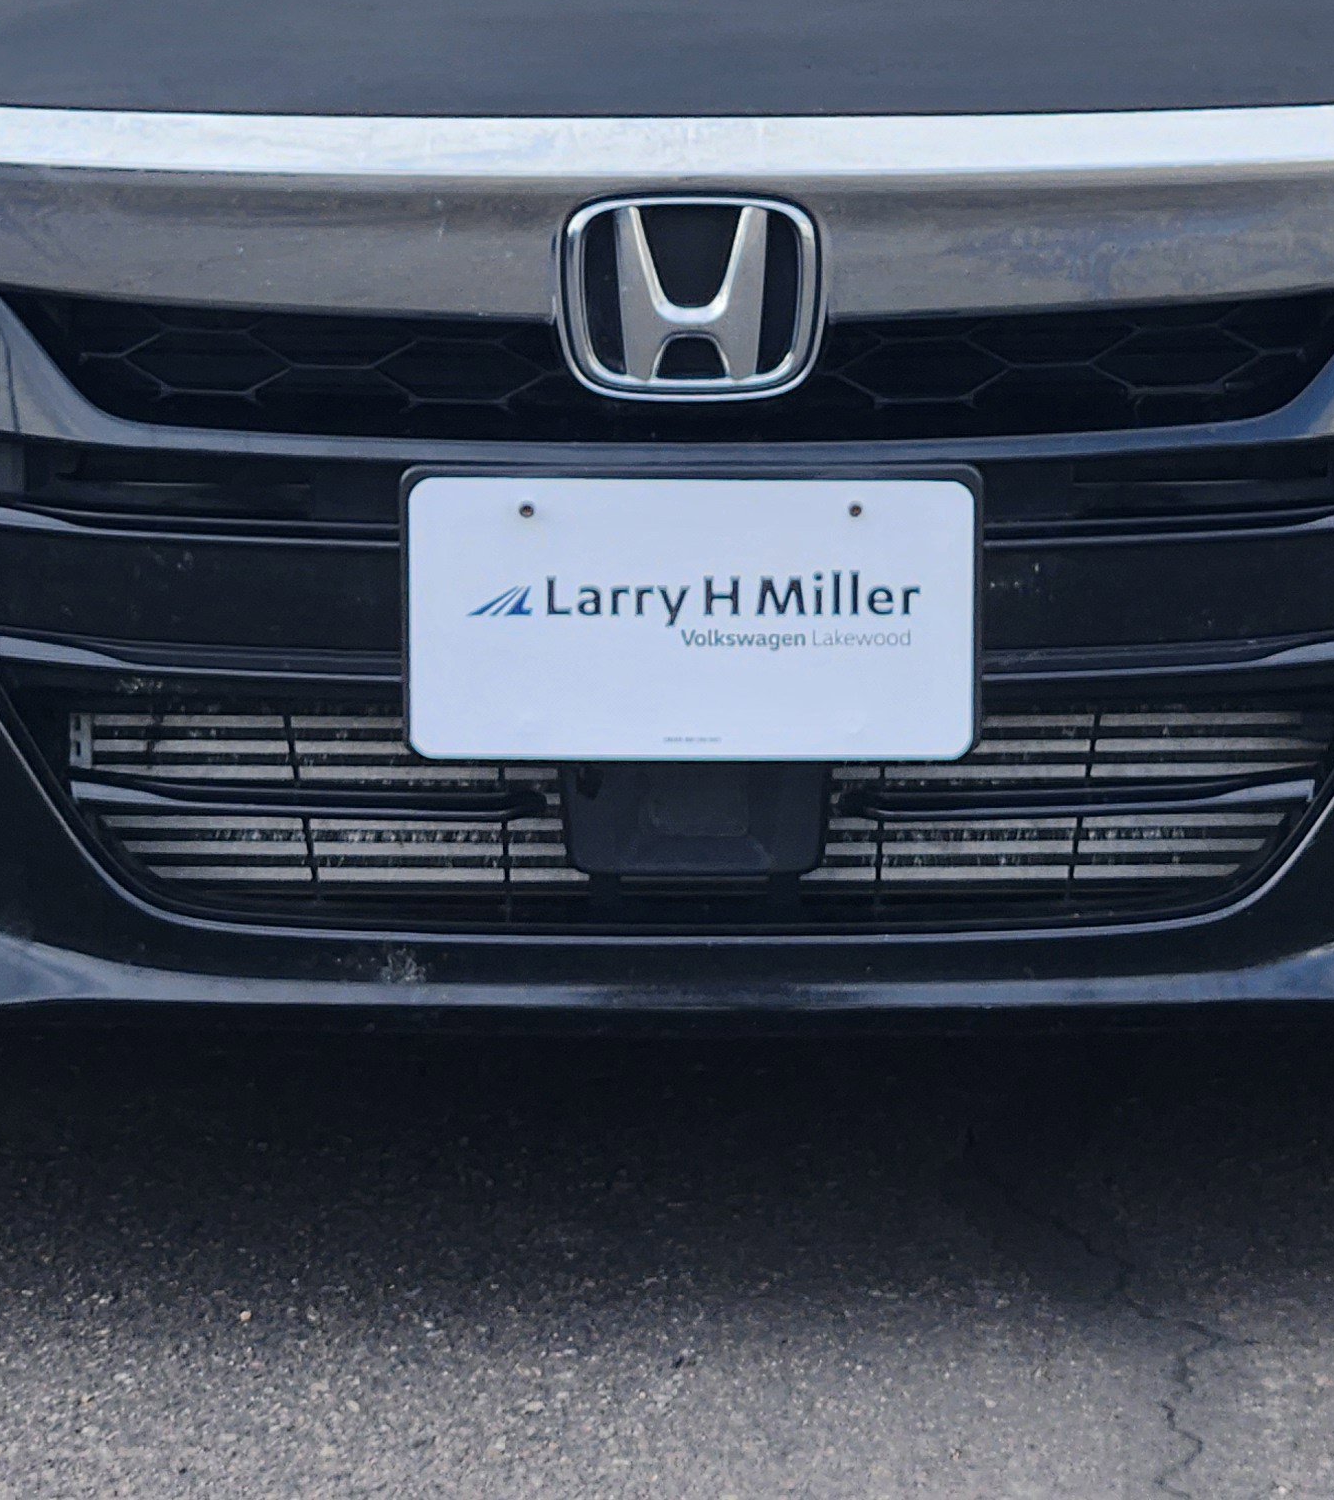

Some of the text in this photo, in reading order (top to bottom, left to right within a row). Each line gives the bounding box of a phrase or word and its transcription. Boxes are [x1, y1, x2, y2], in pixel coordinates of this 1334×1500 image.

[546, 570, 921, 627] Larry H Miller
[680, 629, 912, 651] Volkswagen Lakewood
